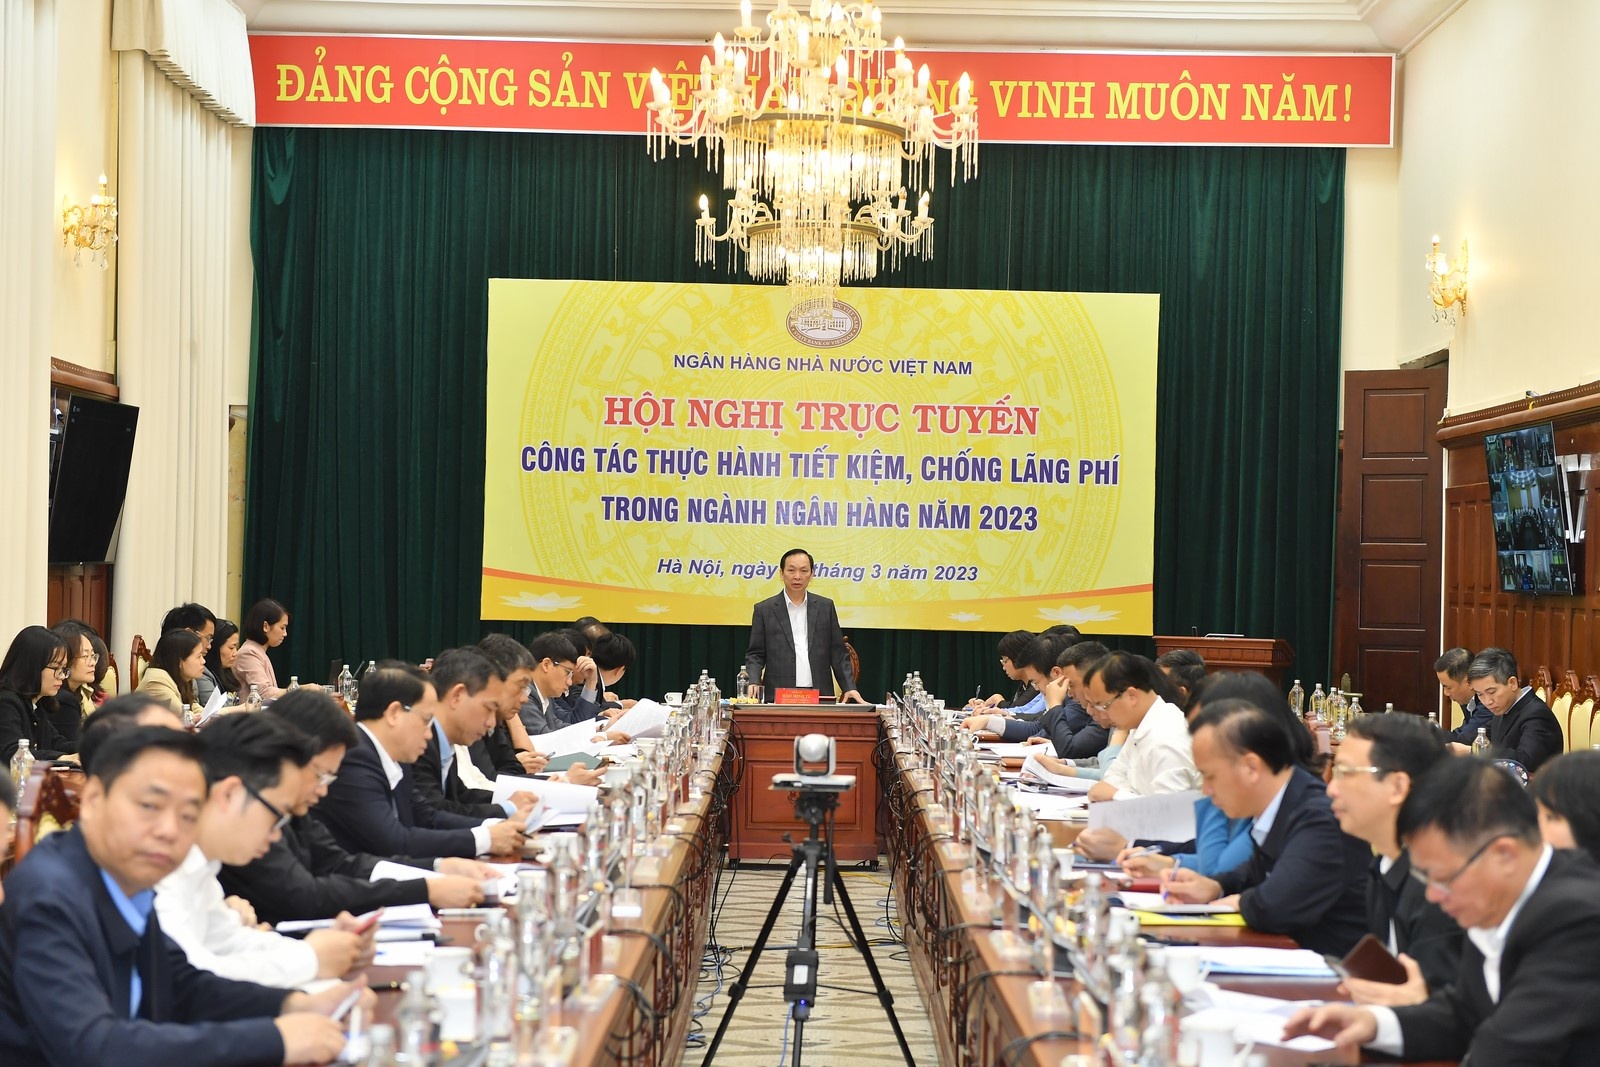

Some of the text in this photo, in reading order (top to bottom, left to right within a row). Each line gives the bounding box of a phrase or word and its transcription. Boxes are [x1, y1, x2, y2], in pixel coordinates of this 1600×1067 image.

[276, 45, 394, 104] ĐẢNG
[404, 53, 519, 116] CỘNG
[528, 51, 611, 109] SẢN
[988, 80, 1096, 119] VINH
[1105, 69, 1231, 121] MUÔN
[1240, 72, 1352, 123] NĂM!
[674, 352, 973, 377] NGÂN HÀNG NHÀ NƯỚC VIỆT NAM
[603, 391, 1040, 439] HỘI NGHỊ TRỰC TUYẾN
[521, 441, 1120, 486] CÔNG TÁC THỰC HÀNH TIẾT KIỆM, CHỐNG LÃNG PHÍ
[601, 494, 1038, 531] TRONG NGÀNH NGÂN HÀNG NĂM 2023
[657, 559, 682, 575] Hà
[689, 559, 724, 580] Nội,
[731, 563, 779, 580] ngày
[871, 565, 882, 579] 3
[886, 564, 928, 580] năm
[934, 566, 978, 581] 2023
